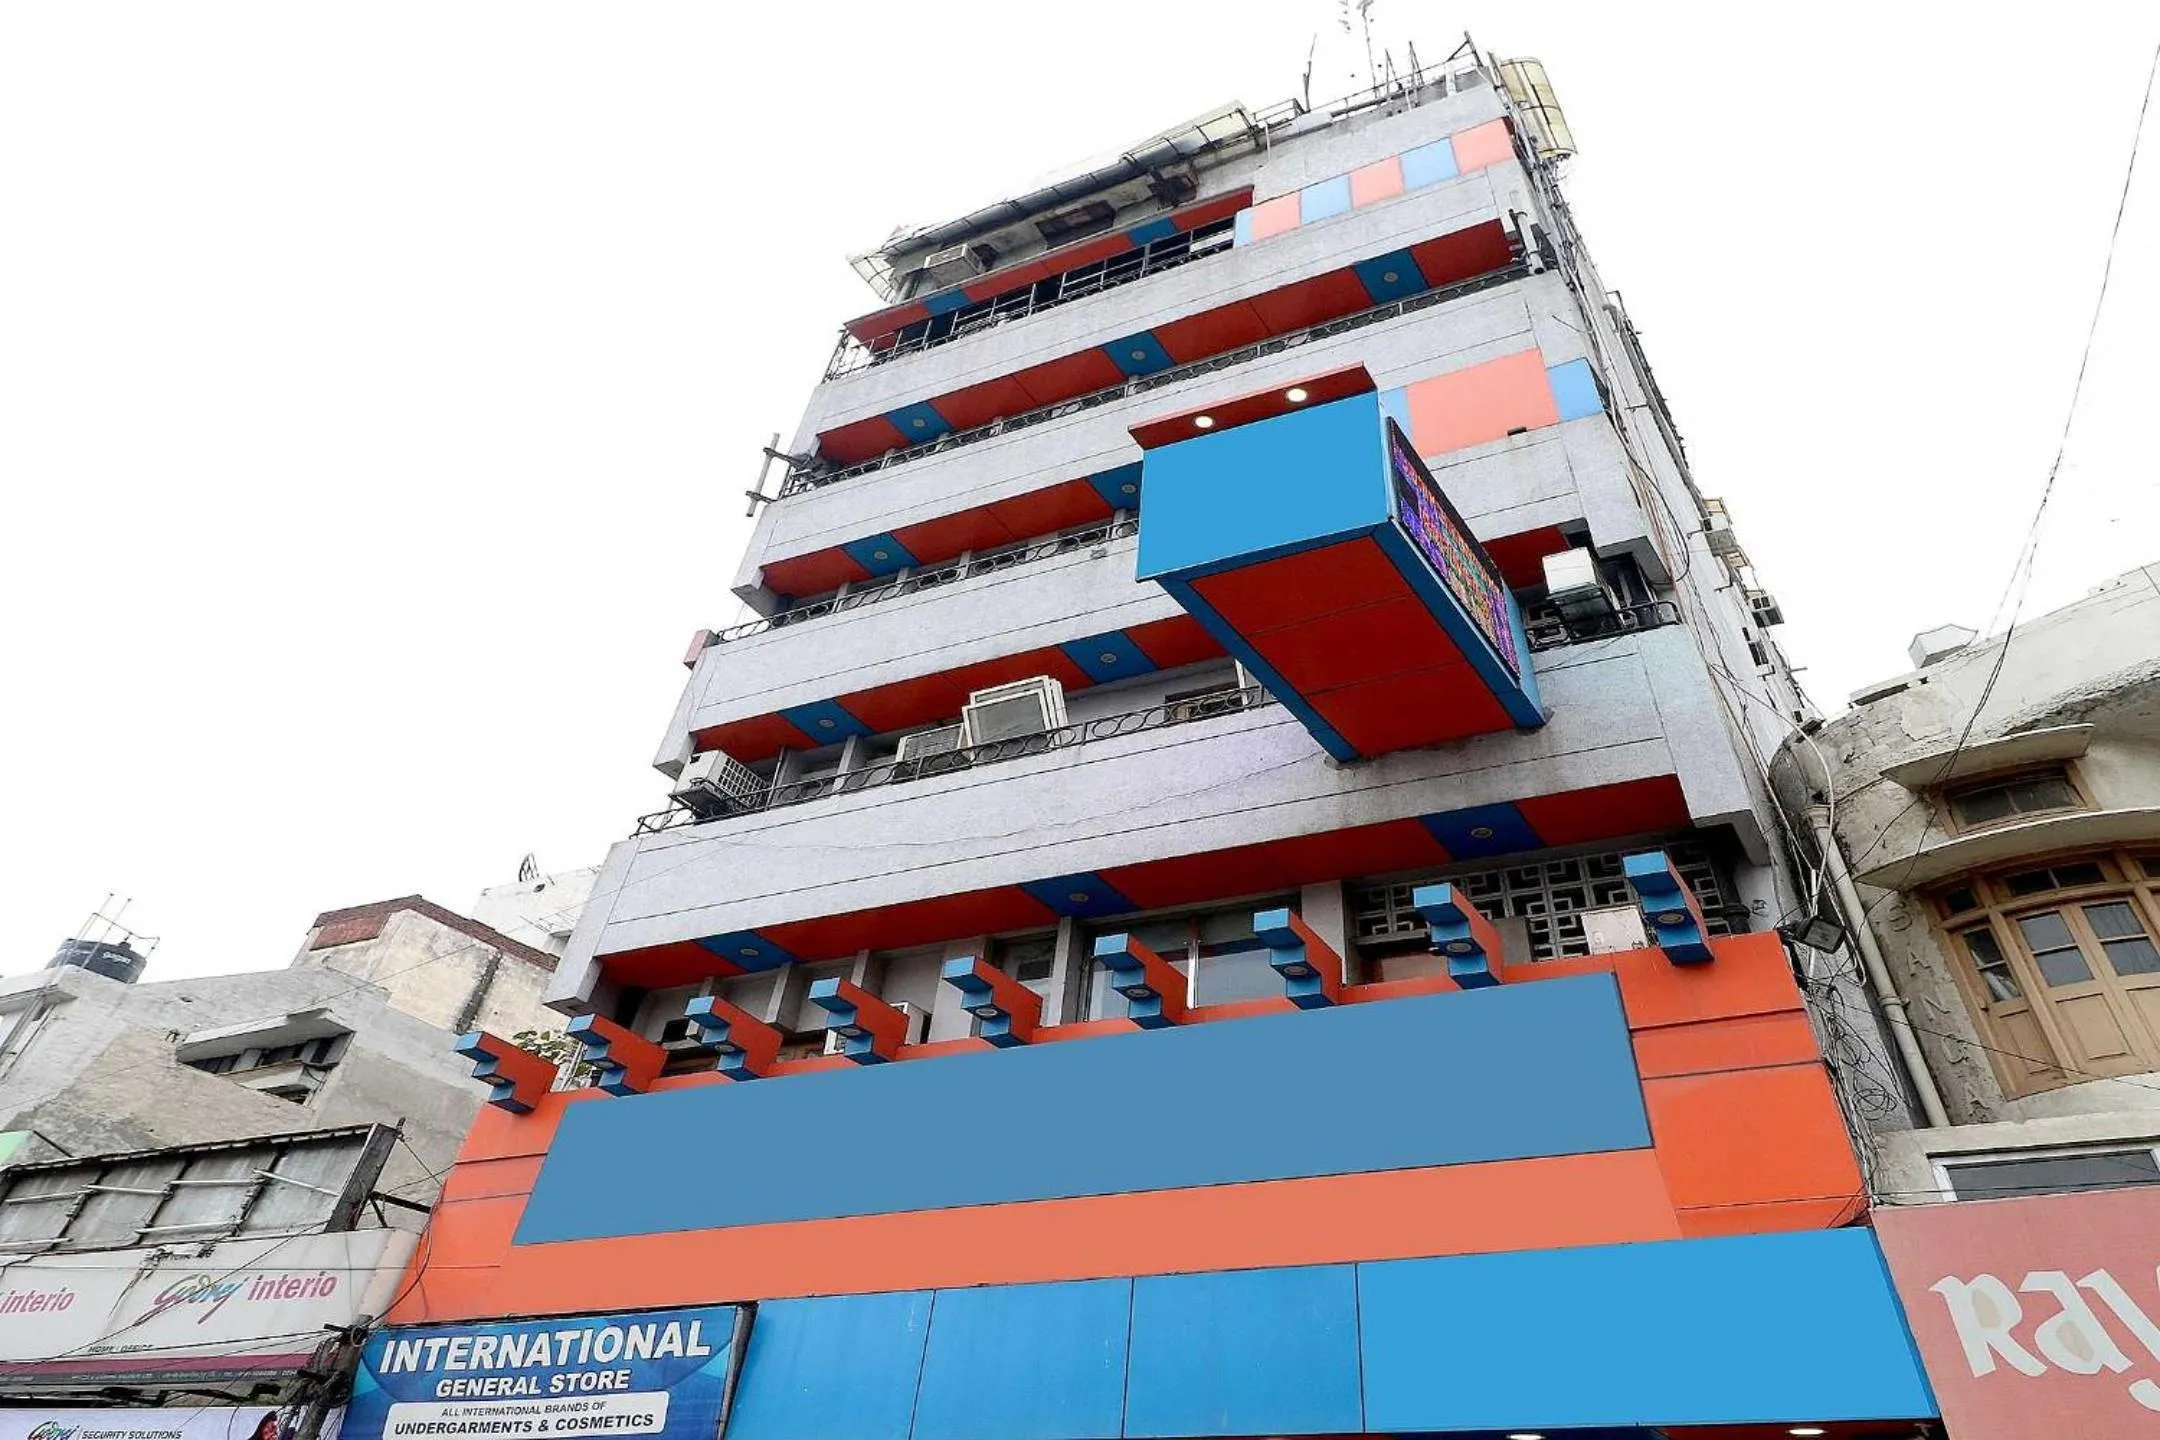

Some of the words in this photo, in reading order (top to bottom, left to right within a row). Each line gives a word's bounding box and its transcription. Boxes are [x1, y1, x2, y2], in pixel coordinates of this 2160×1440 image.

[0, 1286, 76, 1314] interio
[247, 1271, 338, 1301] interio
[379, 1318, 712, 1375] INTERNATIONAL
[434, 1376, 542, 1399] GENERAL
[549, 1368, 633, 1392] STORE
[441, 1406, 461, 1417] ALL
[462, 1405, 542, 1417] INTERNATIONAL
[545, 1402, 590, 1413] BRANDS
[592, 1400, 608, 1412] OF
[82, 1430, 126, 1440] SECURITY
[128, 1430, 183, 1440] SOLUTIONS
[394, 1420, 533, 1436] UNDERGARMENTS
[538, 1418, 550, 1432] &
[555, 1413, 654, 1432] COSMETICS
